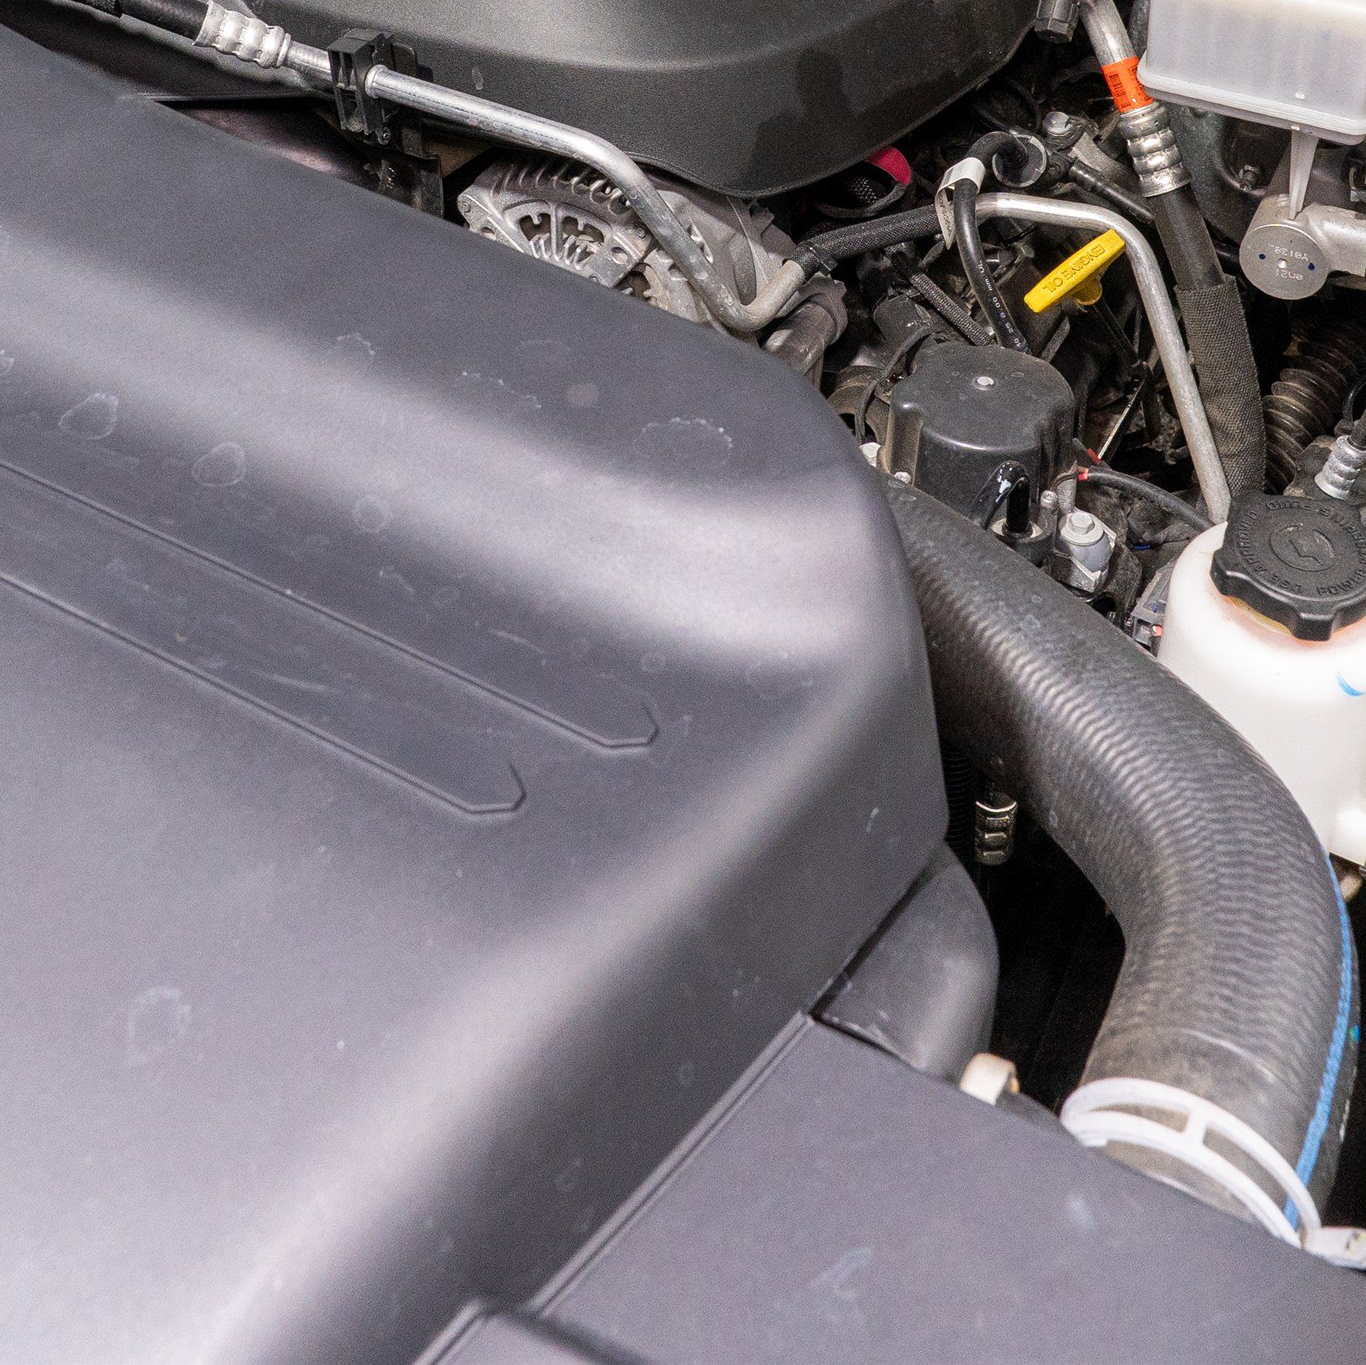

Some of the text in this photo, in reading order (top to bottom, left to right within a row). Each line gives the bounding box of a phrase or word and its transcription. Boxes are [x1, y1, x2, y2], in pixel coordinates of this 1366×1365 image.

[1042, 243, 1106, 293] ENGINE OIL
[1237, 509, 1267, 578] APPROVED
